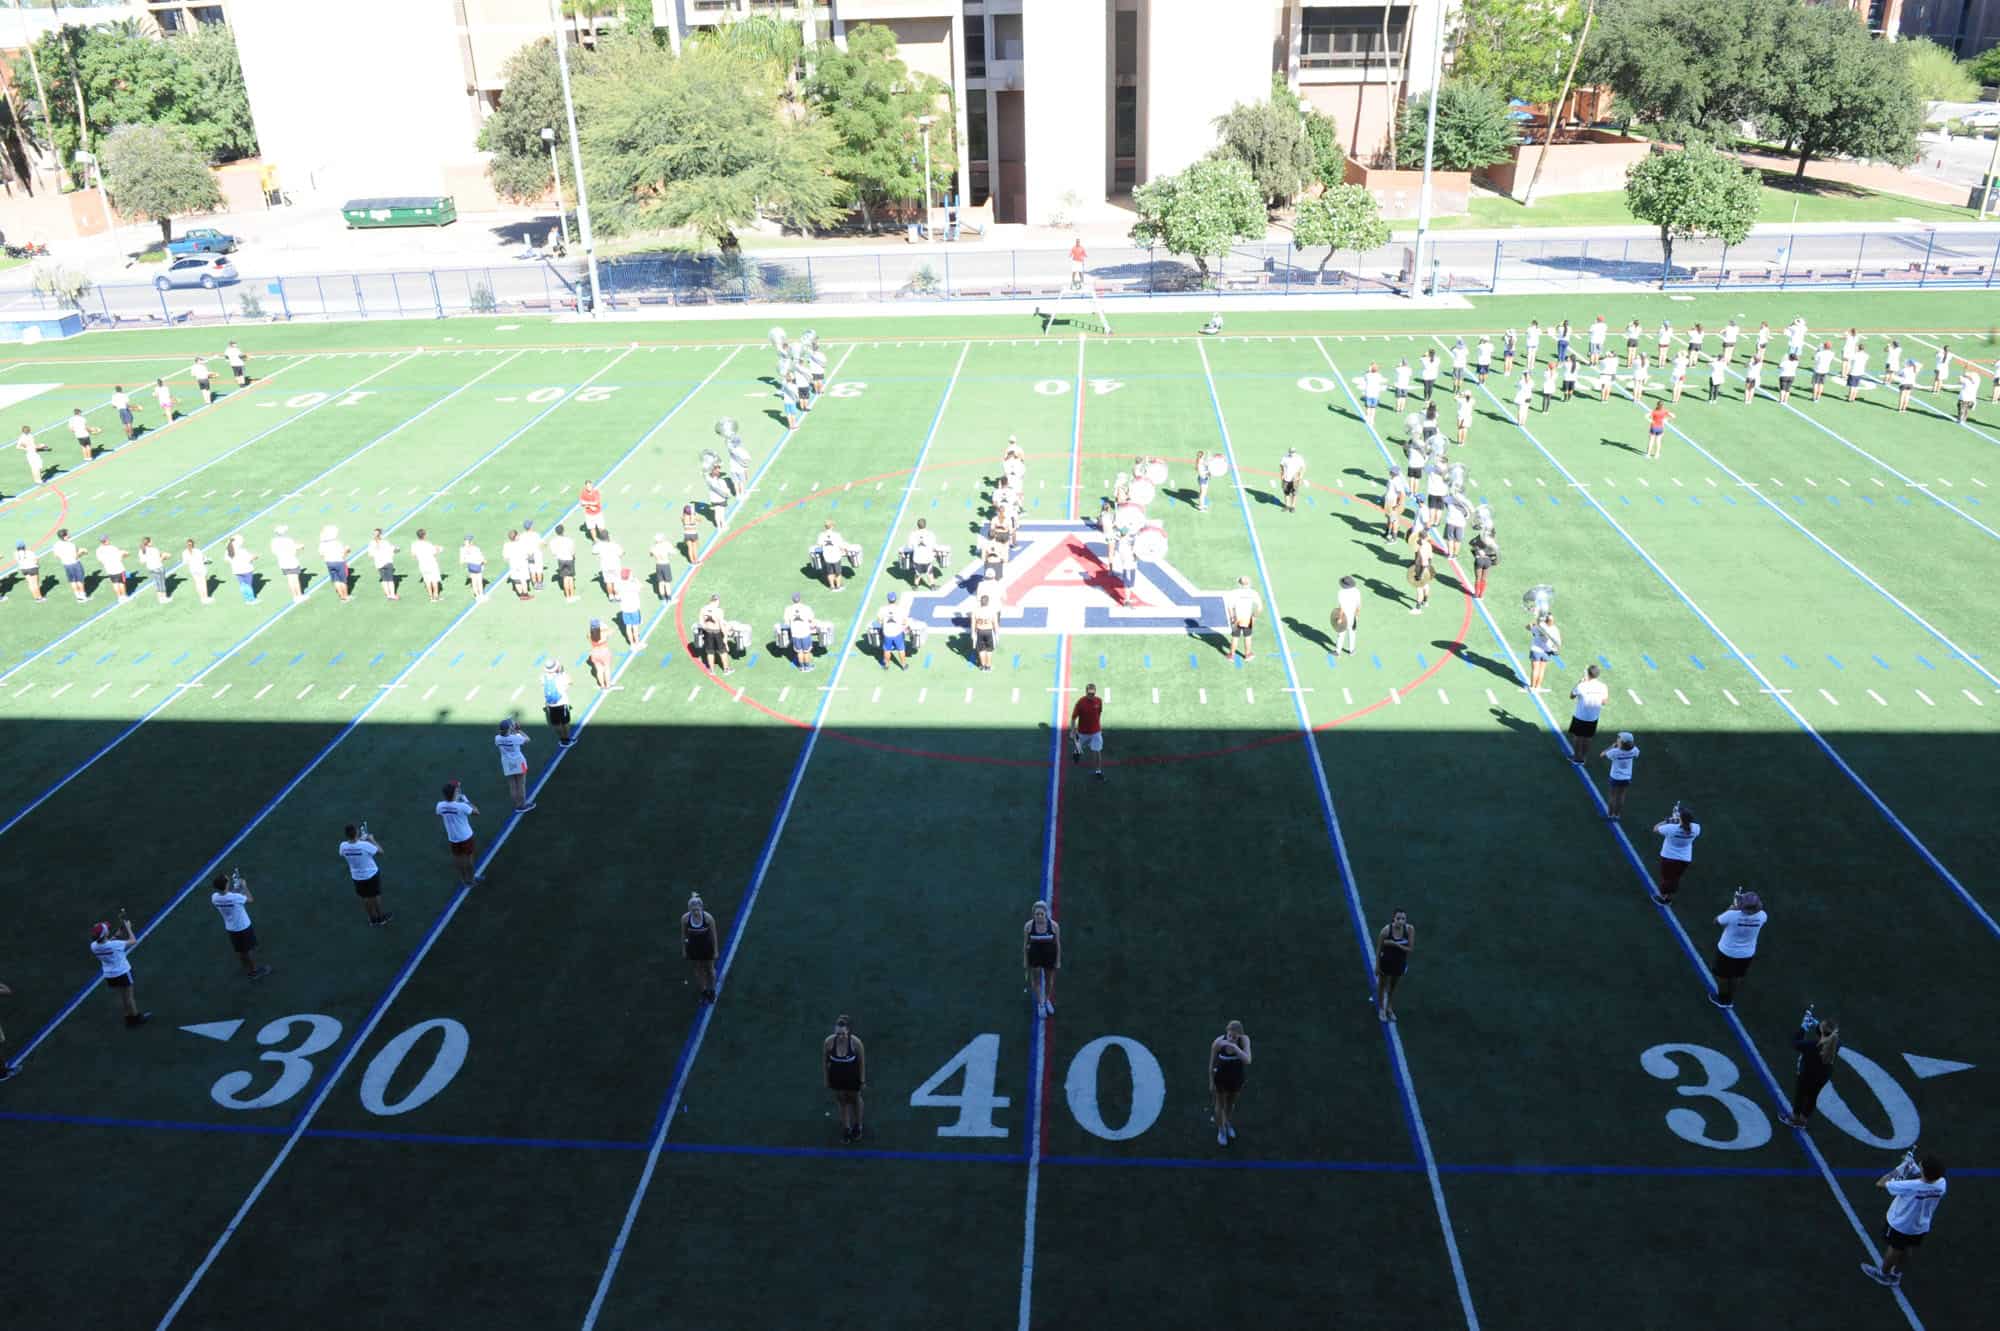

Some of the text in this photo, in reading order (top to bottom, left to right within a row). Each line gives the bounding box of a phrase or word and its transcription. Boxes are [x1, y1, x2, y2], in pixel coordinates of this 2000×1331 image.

[210, 1013, 470, 1116] 30
[909, 1033, 1166, 1141] 40
[1640, 1042, 1921, 1149] 30
